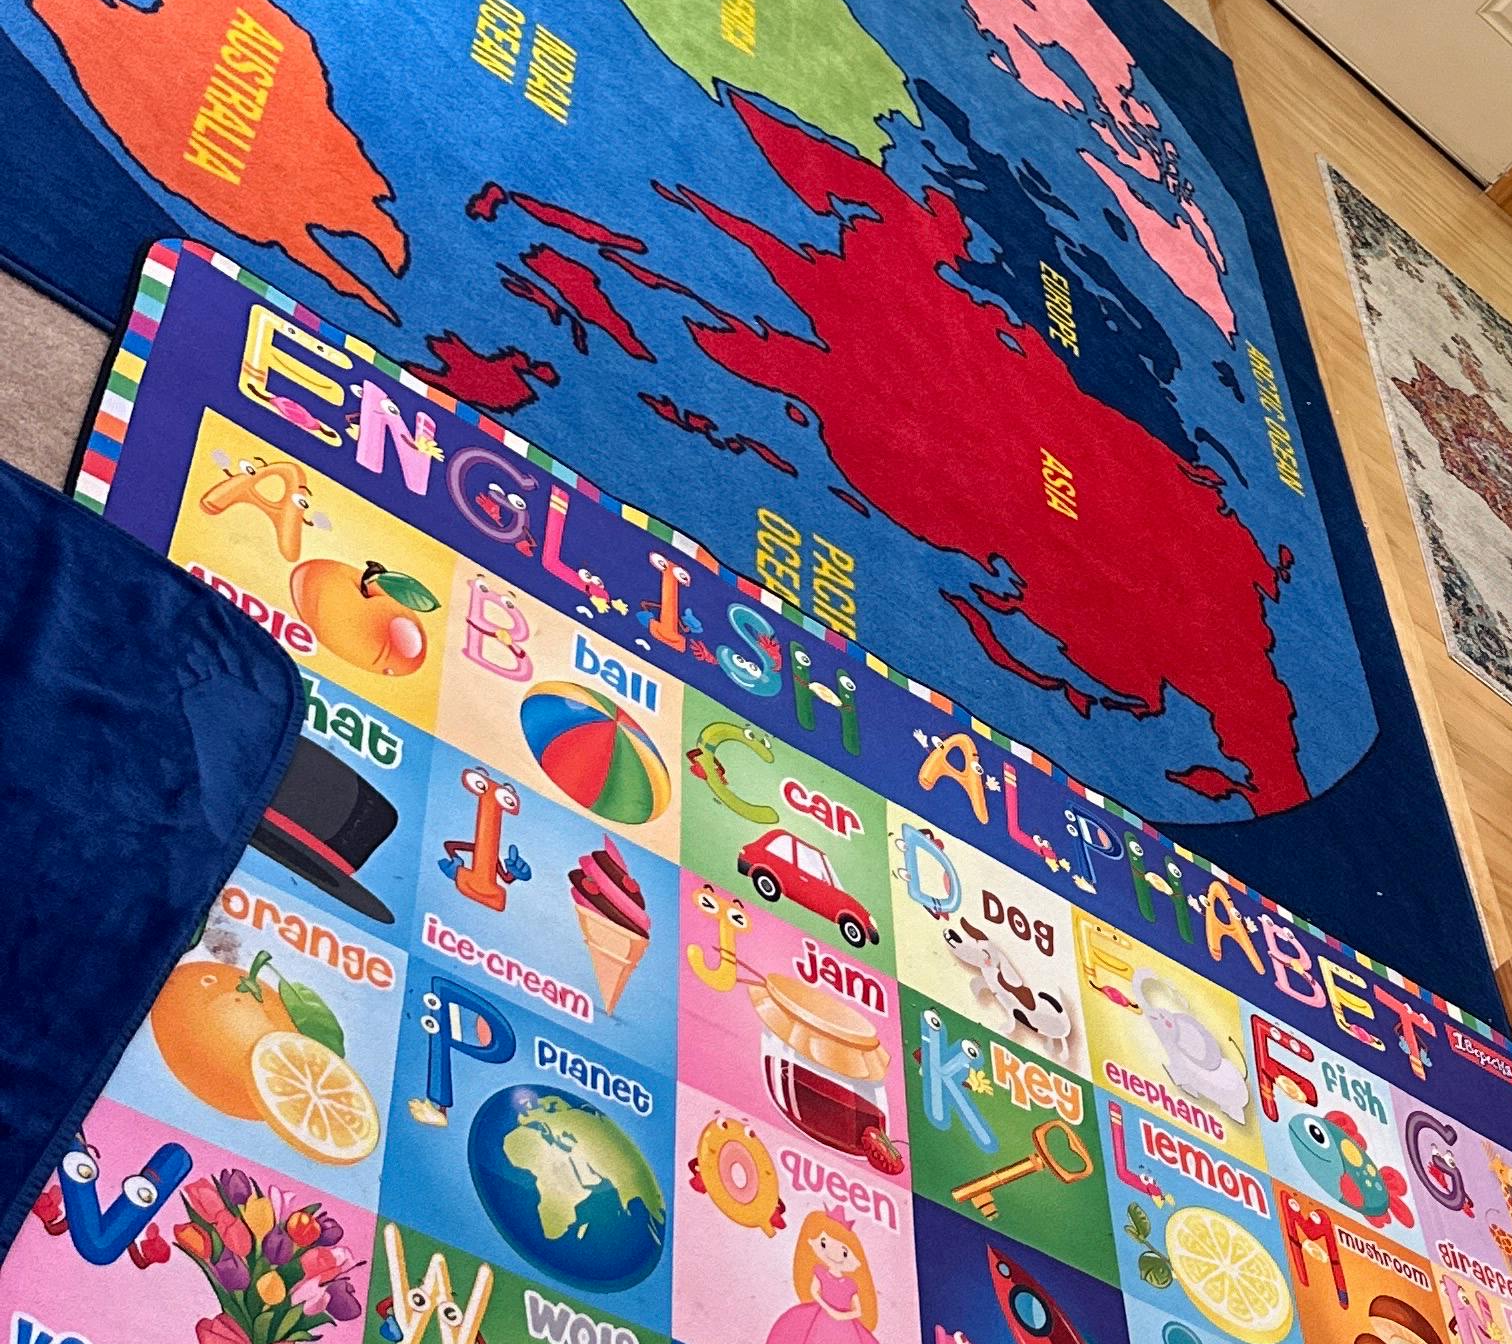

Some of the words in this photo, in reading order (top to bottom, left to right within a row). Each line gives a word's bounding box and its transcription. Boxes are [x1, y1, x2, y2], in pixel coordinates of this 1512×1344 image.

[183, 8, 285, 185] AUSTRALIA
[523, 24, 578, 126] INDIAN
[1039, 260, 1080, 358] EUROPE
[1244, 339, 1286, 422] ARCTIC
[1040, 447, 1079, 520] ASIA
[1264, 416, 1306, 498] OCEAN
[200, 459, 309, 562] A
[239, 304, 861, 756] ENGLISH
[757, 508, 801, 608] OCEA
[462, 578, 533, 681] B
[576, 637, 656, 709] ball
[303, 678, 399, 764] hat
[699, 722, 779, 825] C
[781, 779, 862, 836] car
[455, 769, 517, 910] I
[902, 823, 961, 913] D
[222, 886, 395, 989] orange
[687, 892, 750, 992] J
[918, 733, 1433, 1081] ALPHABET
[982, 890, 1054, 957] Dog
[422, 915, 592, 1020] ice-cream
[795, 942, 886, 1013] jam
[1075, 913, 1142, 1013] E
[420, 976, 517, 1116] P
[538, 1038, 651, 1114] planet
[920, 1008, 998, 1153] K
[991, 1045, 1083, 1123] key
[1251, 1014, 1318, 1122] F
[1323, 1061, 1387, 1124] fish
[1105, 1062, 1225, 1141] elephant
[699, 1116, 783, 1238] Q
[781, 1149, 898, 1229] queen
[1109, 1100, 1172, 1205] L
[1143, 1121, 1270, 1217] lemon
[1406, 1110, 1466, 1218] G
[60, 1142, 193, 1266] V
[1281, 1190, 1350, 1309] M
[1338, 1225, 1430, 1291] mushroom
